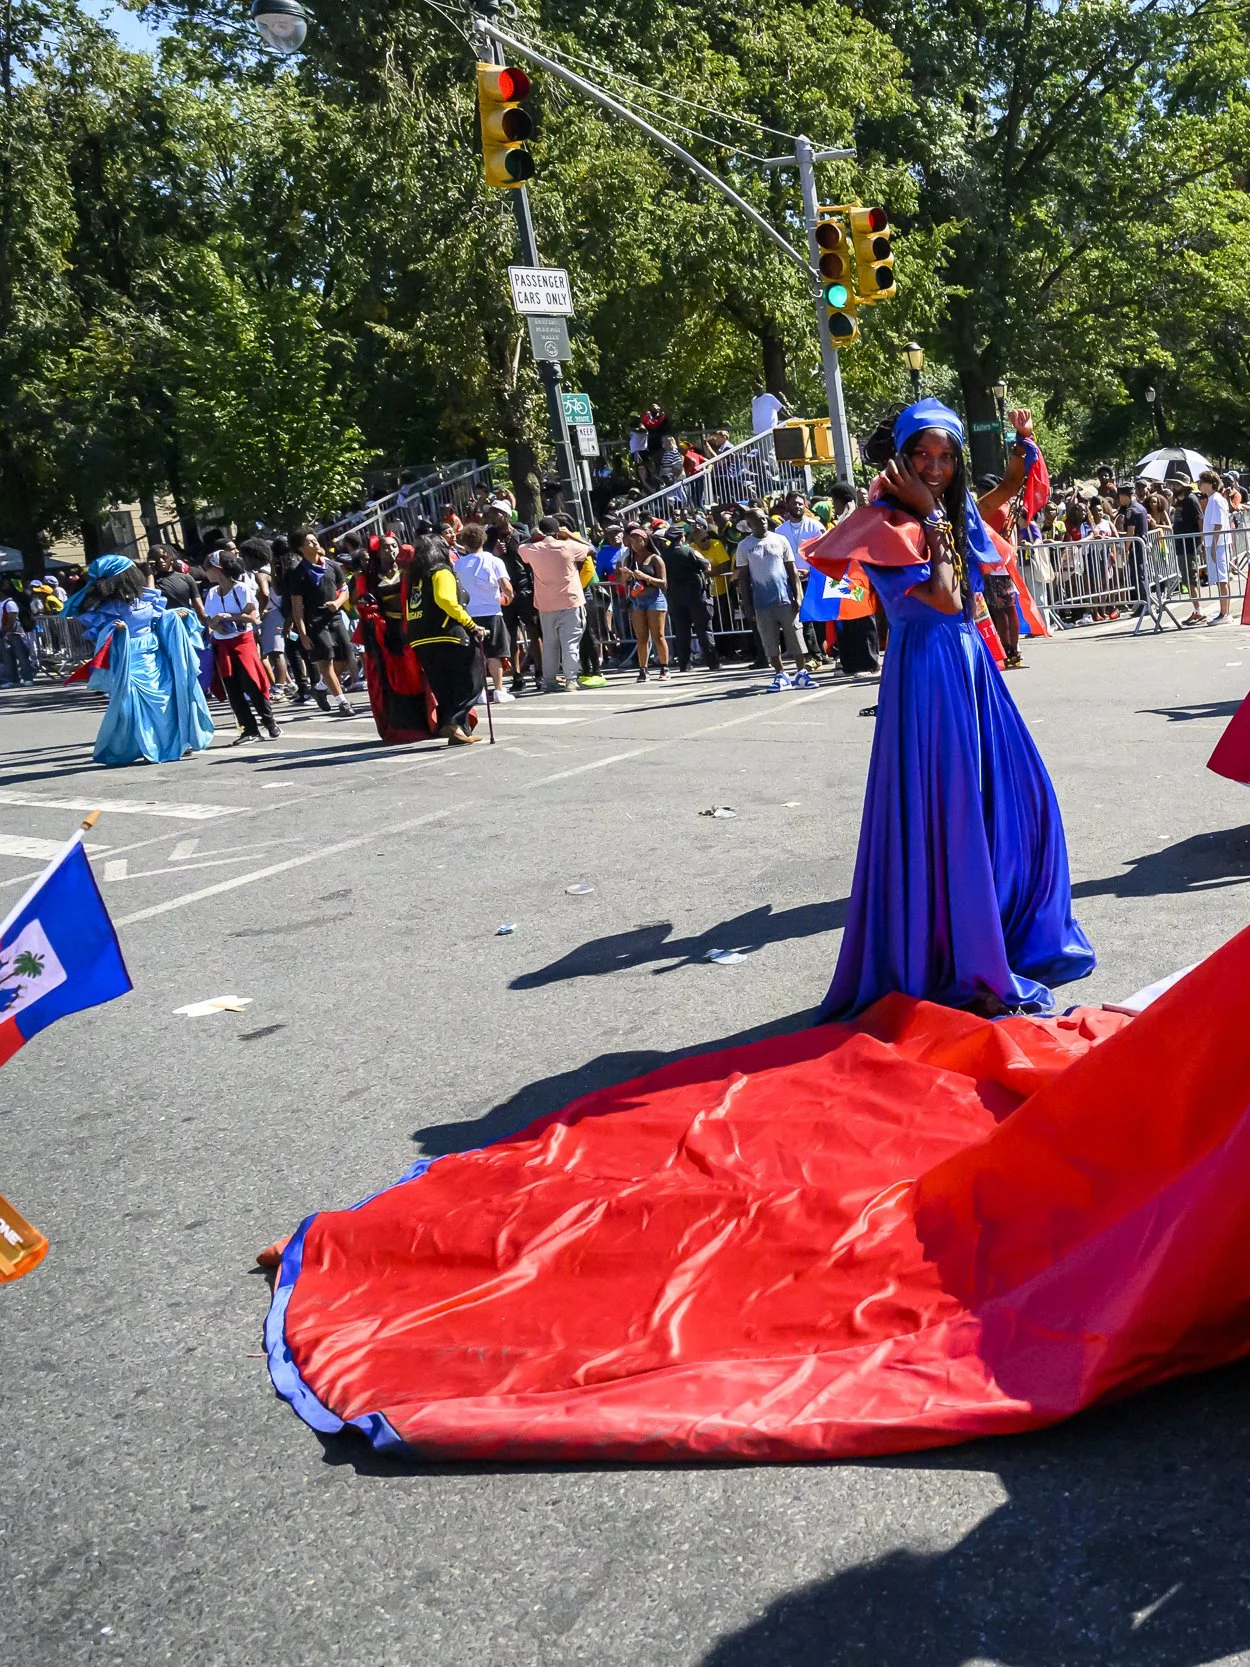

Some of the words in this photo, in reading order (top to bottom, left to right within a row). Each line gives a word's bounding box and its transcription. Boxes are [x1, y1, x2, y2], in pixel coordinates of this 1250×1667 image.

[514, 274, 565, 288] PASSENGER
[517, 291, 541, 304] CARS
[545, 293, 567, 305] ONLY
[579, 428, 593, 436] KEEP
